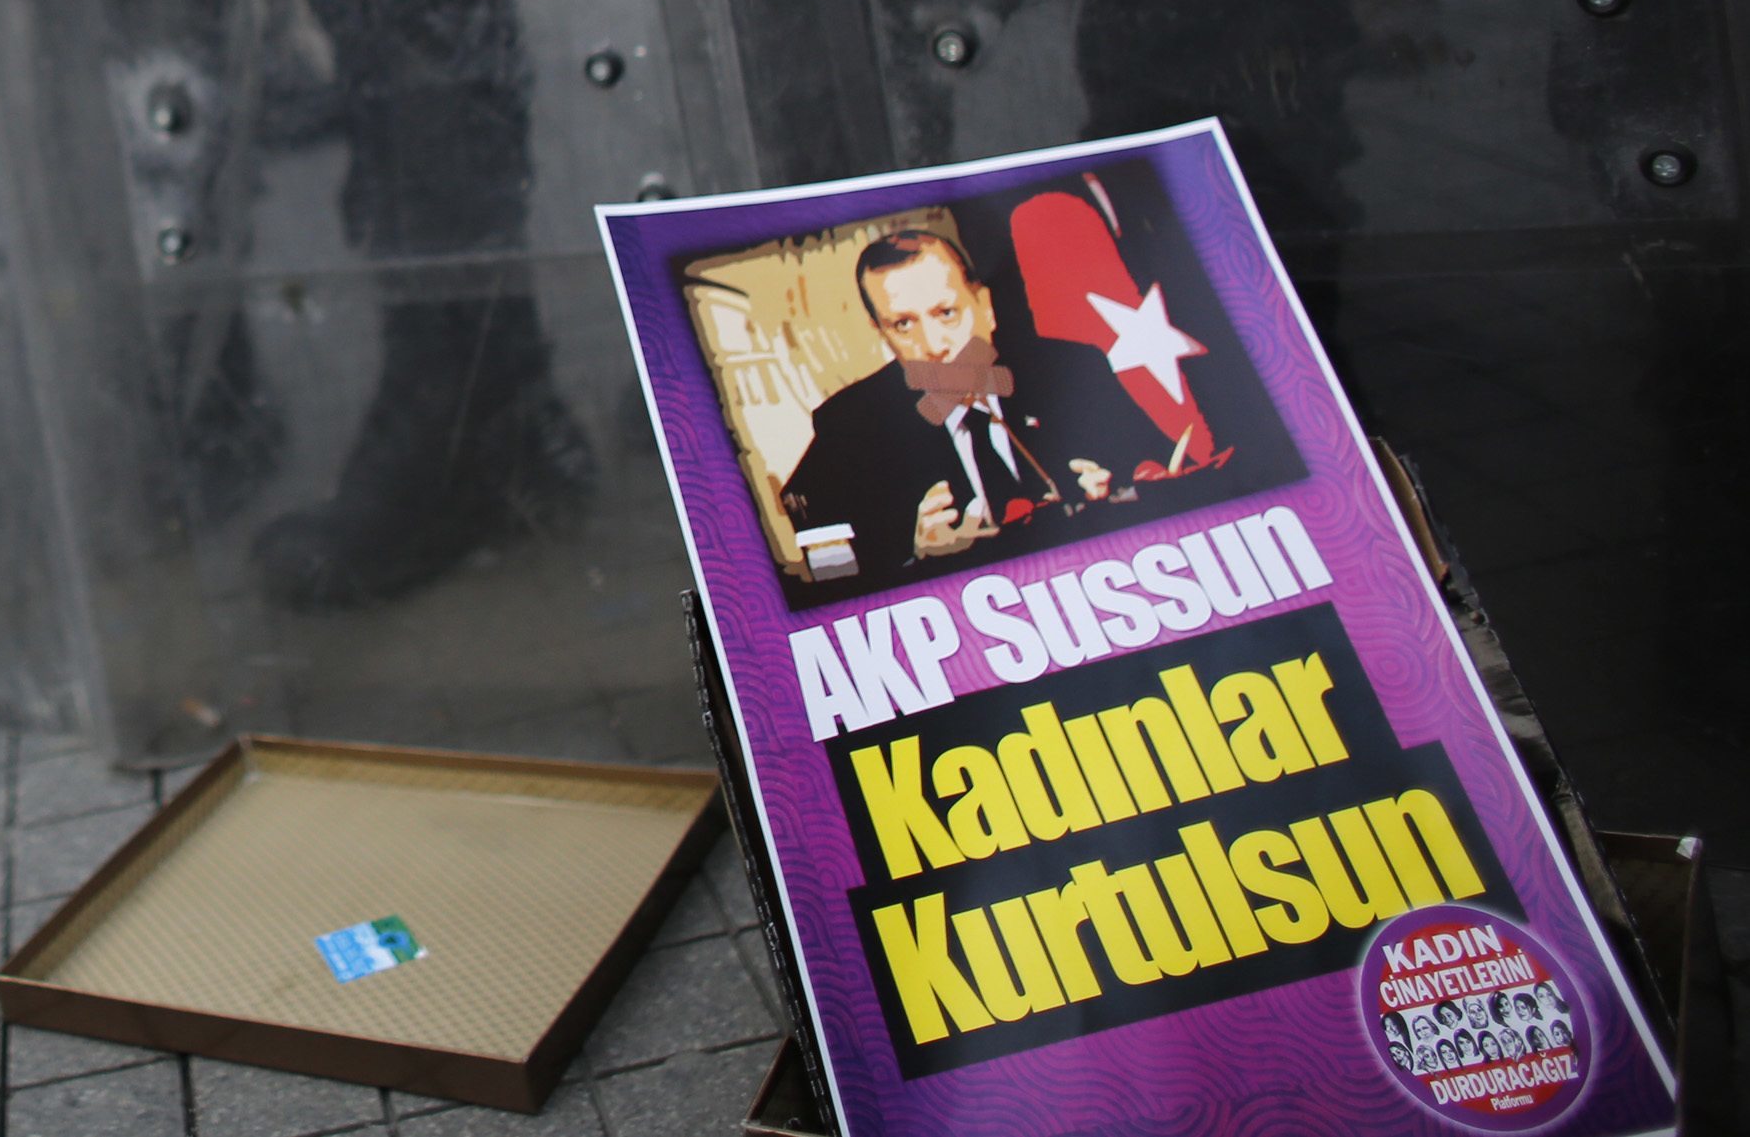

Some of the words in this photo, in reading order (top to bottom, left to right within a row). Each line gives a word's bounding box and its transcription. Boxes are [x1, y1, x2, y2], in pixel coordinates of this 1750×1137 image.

[788, 596, 959, 742] AKP
[961, 505, 1333, 683] Sussun
[850, 652, 1349, 880] Kadınlar
[872, 788, 1486, 1045] Kurtulsun
[1379, 948, 1535, 1008] CİNAYETLERİNİ
[1382, 924, 1503, 973] KADIN
[1430, 1051, 1579, 1105] DURDURACAĞIZ
[1490, 1094, 1534, 1111] Platformu
